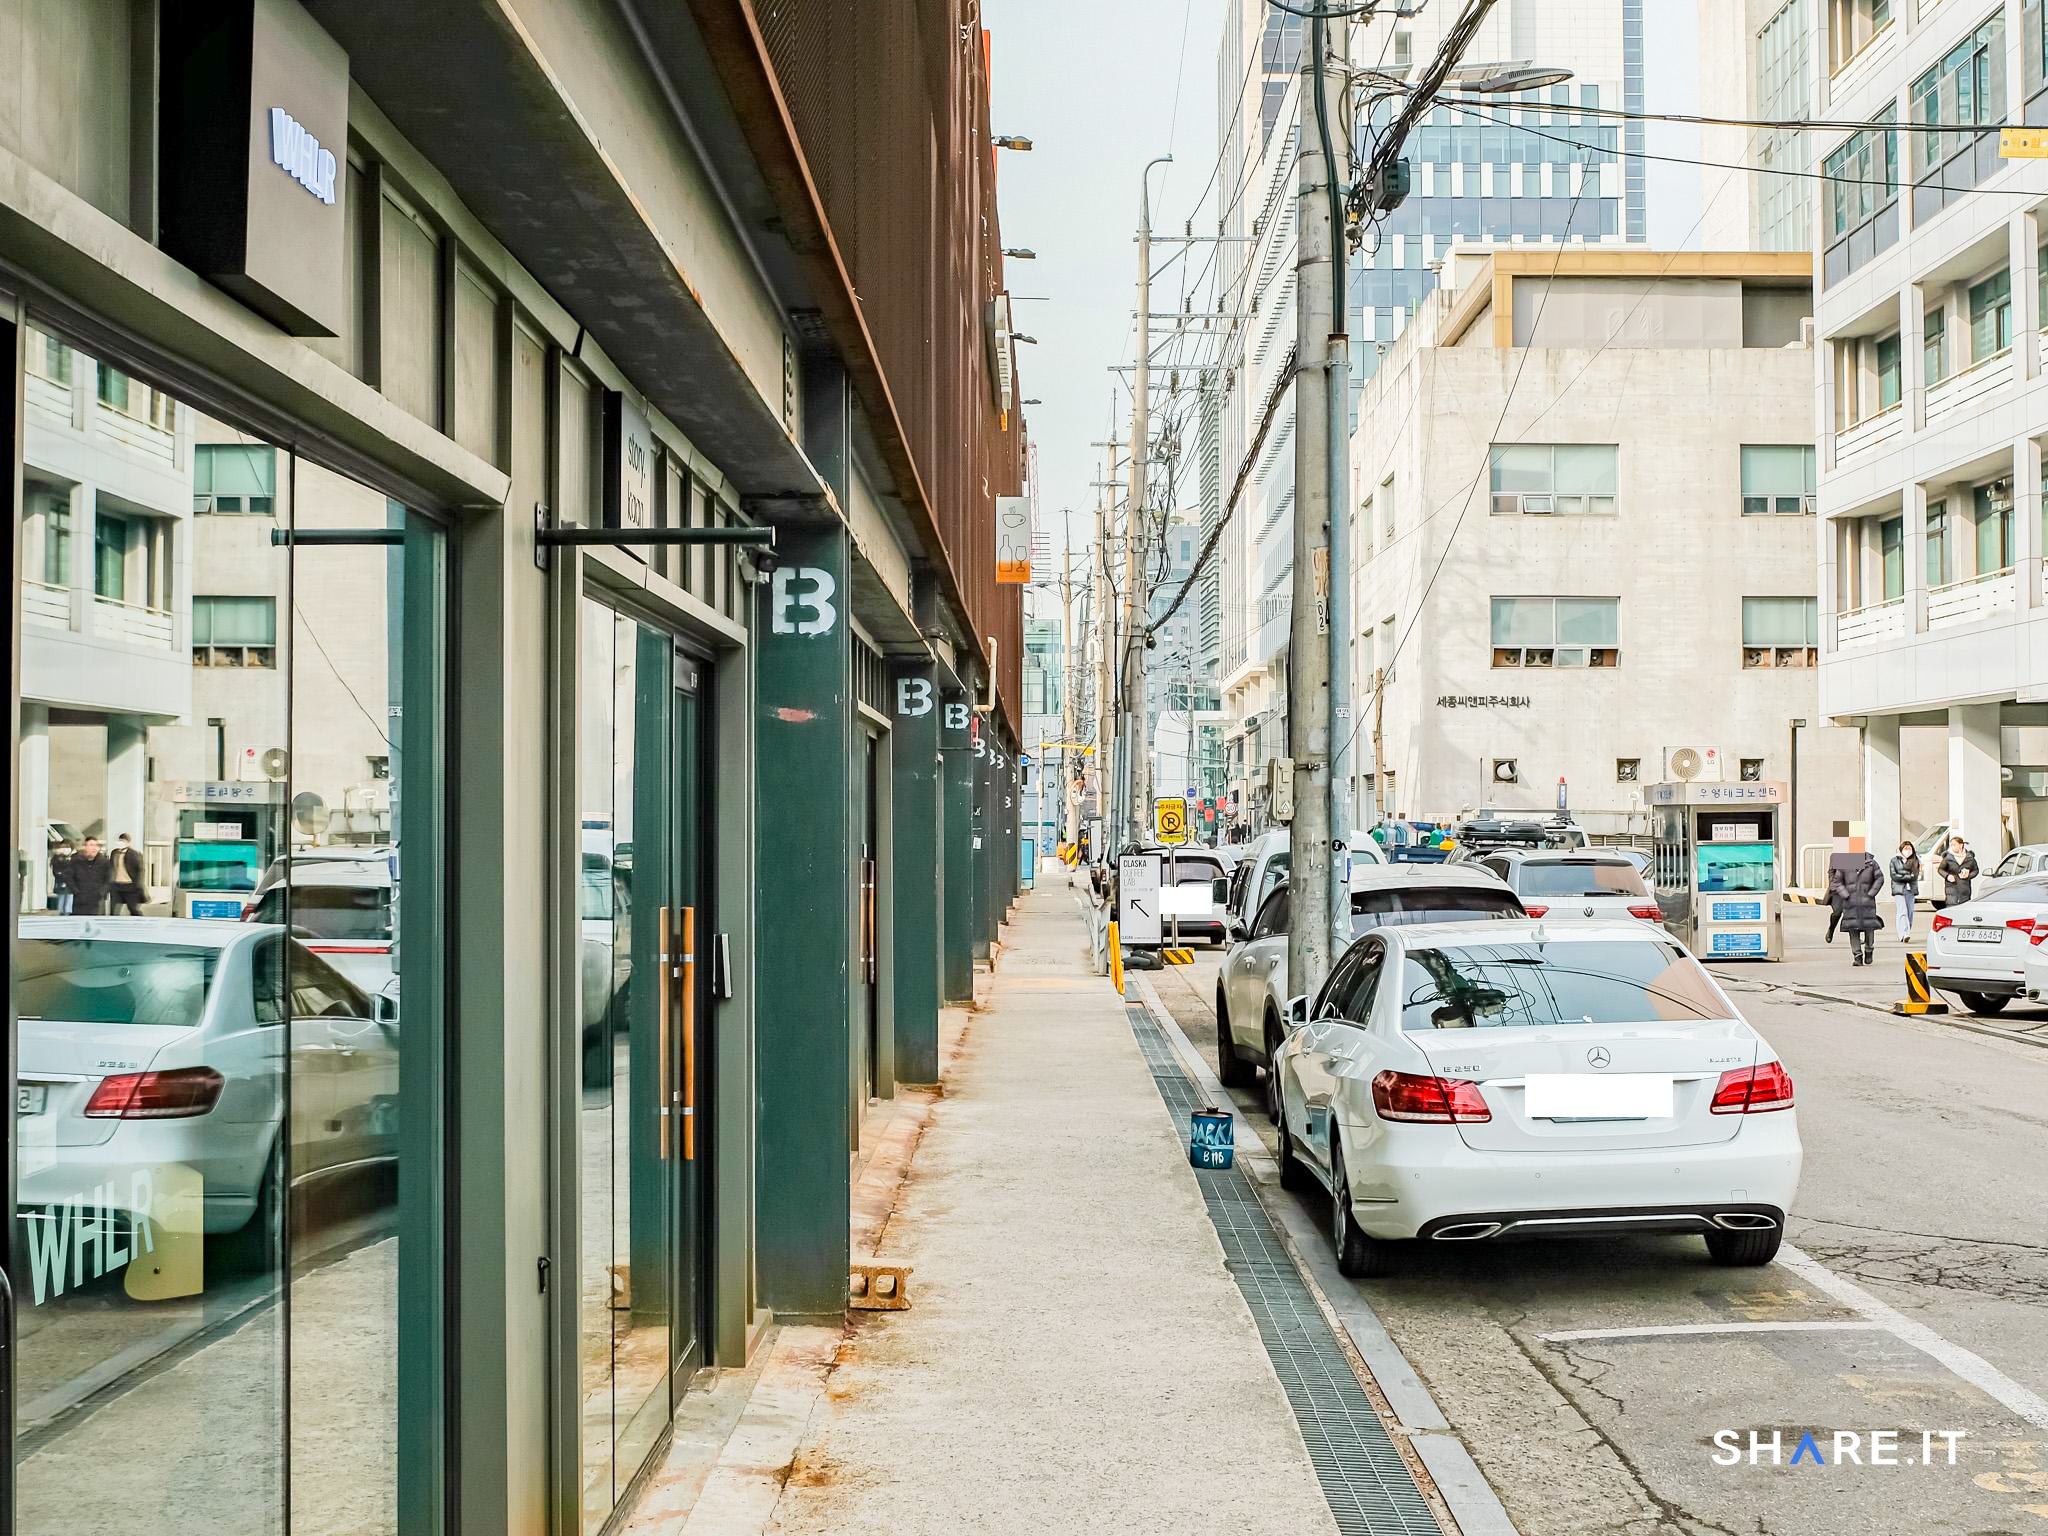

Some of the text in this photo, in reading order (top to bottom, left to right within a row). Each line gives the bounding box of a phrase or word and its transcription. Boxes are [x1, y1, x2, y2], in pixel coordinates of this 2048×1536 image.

[772, 567, 837, 634] B
[897, 678, 933, 716] B
[1436, 695, 1531, 708] 세종씨앤피주식회사
[945, 703, 970, 730] B
[26, 1169, 154, 1307] WHLR
